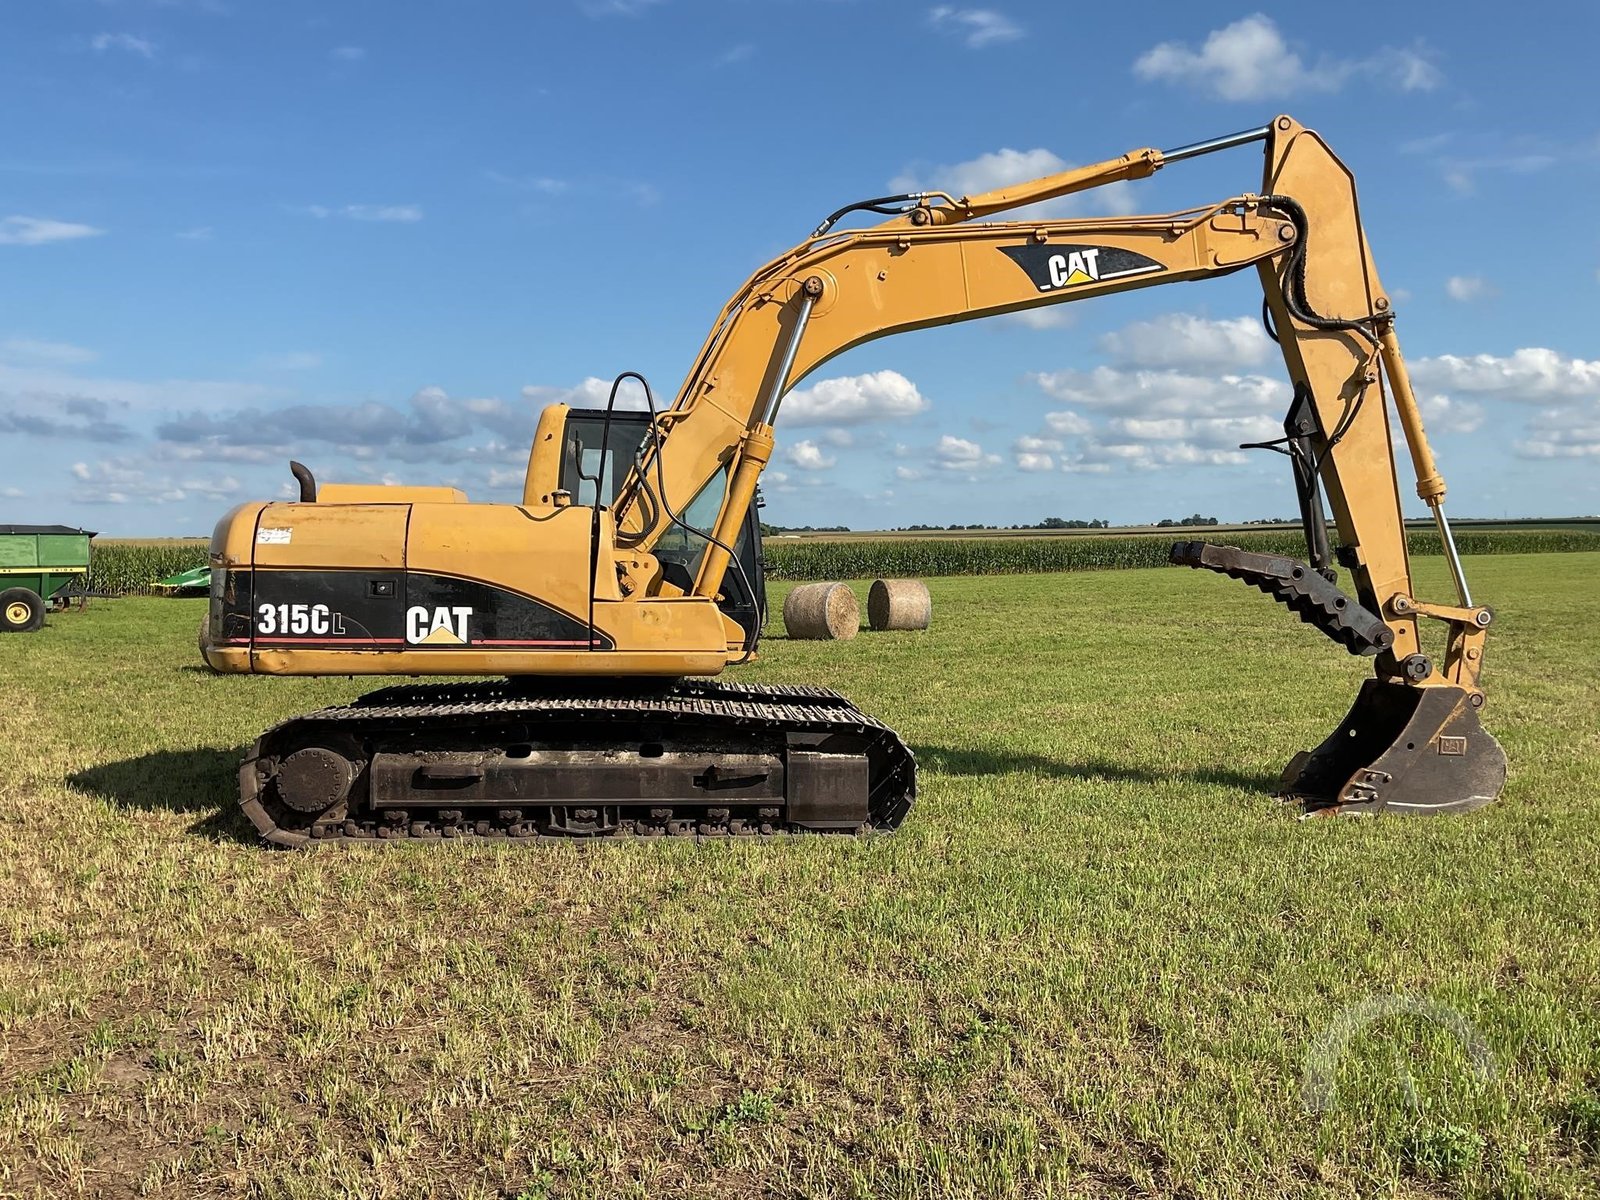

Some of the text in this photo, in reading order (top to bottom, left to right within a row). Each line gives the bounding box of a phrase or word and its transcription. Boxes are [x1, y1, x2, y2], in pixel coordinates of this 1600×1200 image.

[1048, 248, 1099, 287] CAT
[258, 603, 330, 635] 315C
[406, 605, 473, 645] CAT
